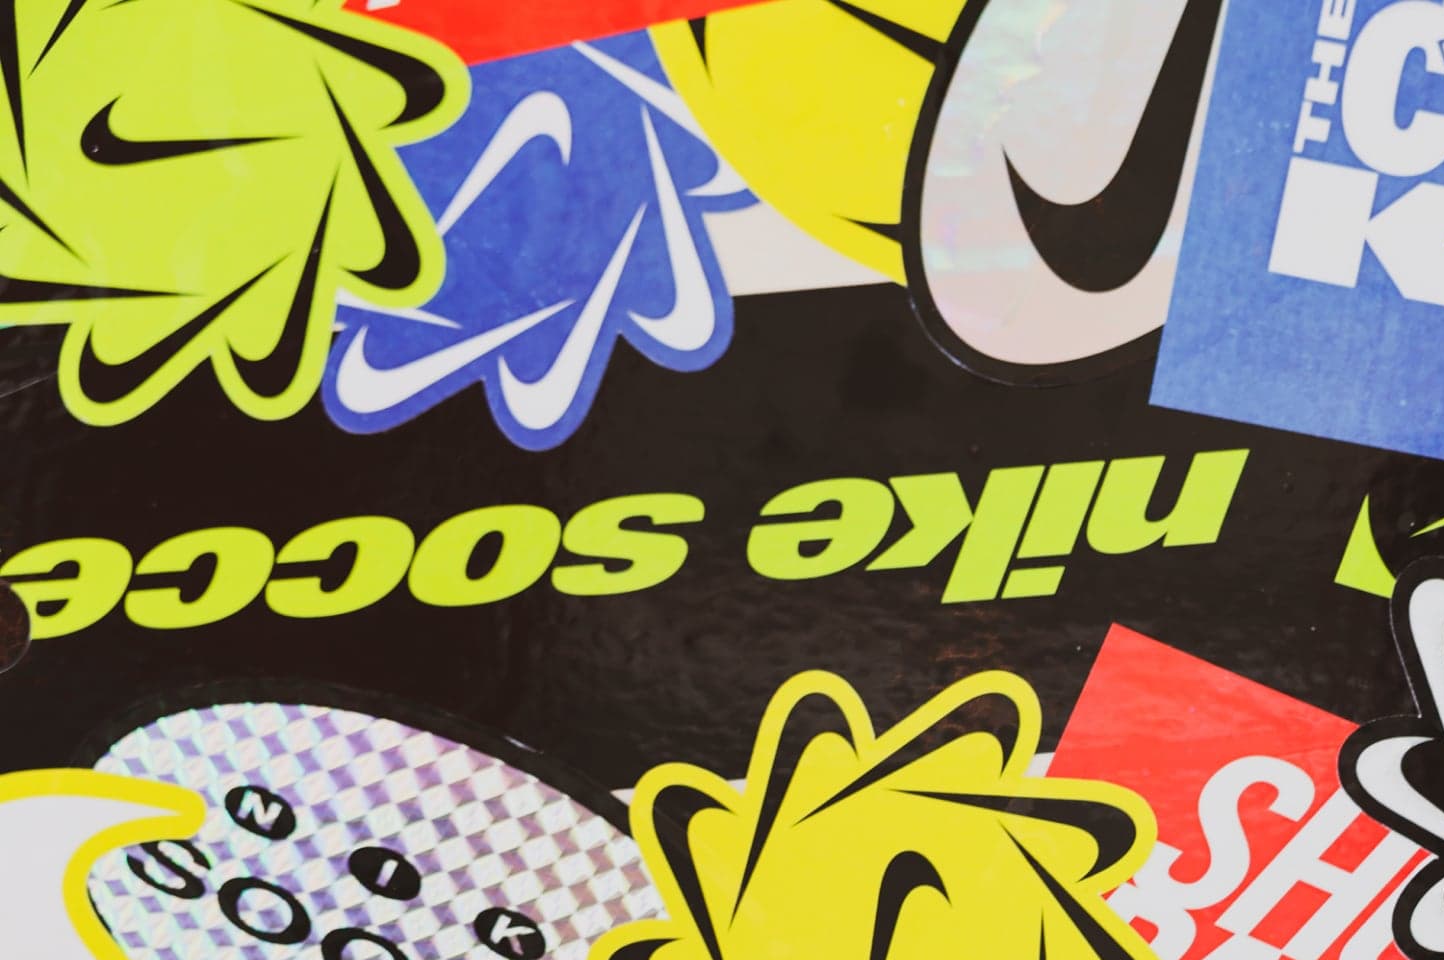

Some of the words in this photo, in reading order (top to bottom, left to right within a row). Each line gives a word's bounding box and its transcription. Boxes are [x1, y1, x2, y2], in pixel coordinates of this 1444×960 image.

[1293, 0, 1355, 153] THE
[0, 493, 706, 640] socce
[746, 448, 1249, 604] nike
